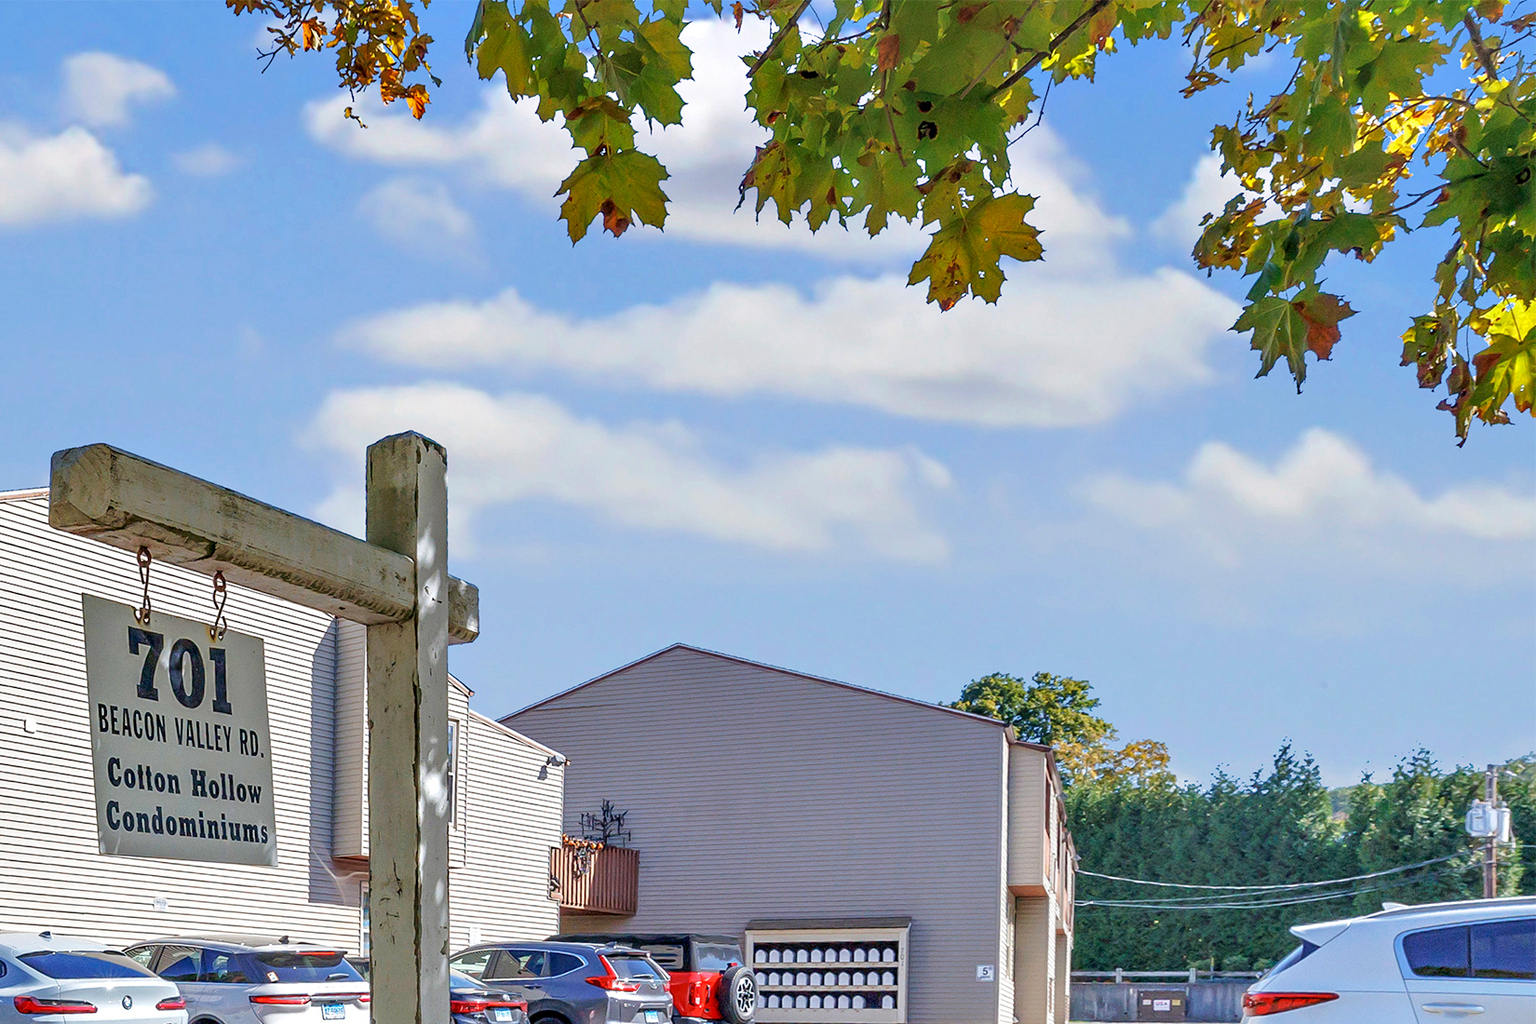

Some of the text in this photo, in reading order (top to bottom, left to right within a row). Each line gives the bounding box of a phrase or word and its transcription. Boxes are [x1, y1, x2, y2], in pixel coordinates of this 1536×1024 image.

[127, 625, 233, 715] 701
[97, 703, 264, 758] BEACON VALLEY RD.
[107, 757, 262, 804] Cotton Hollow
[106, 800, 268, 844] Condominiums
